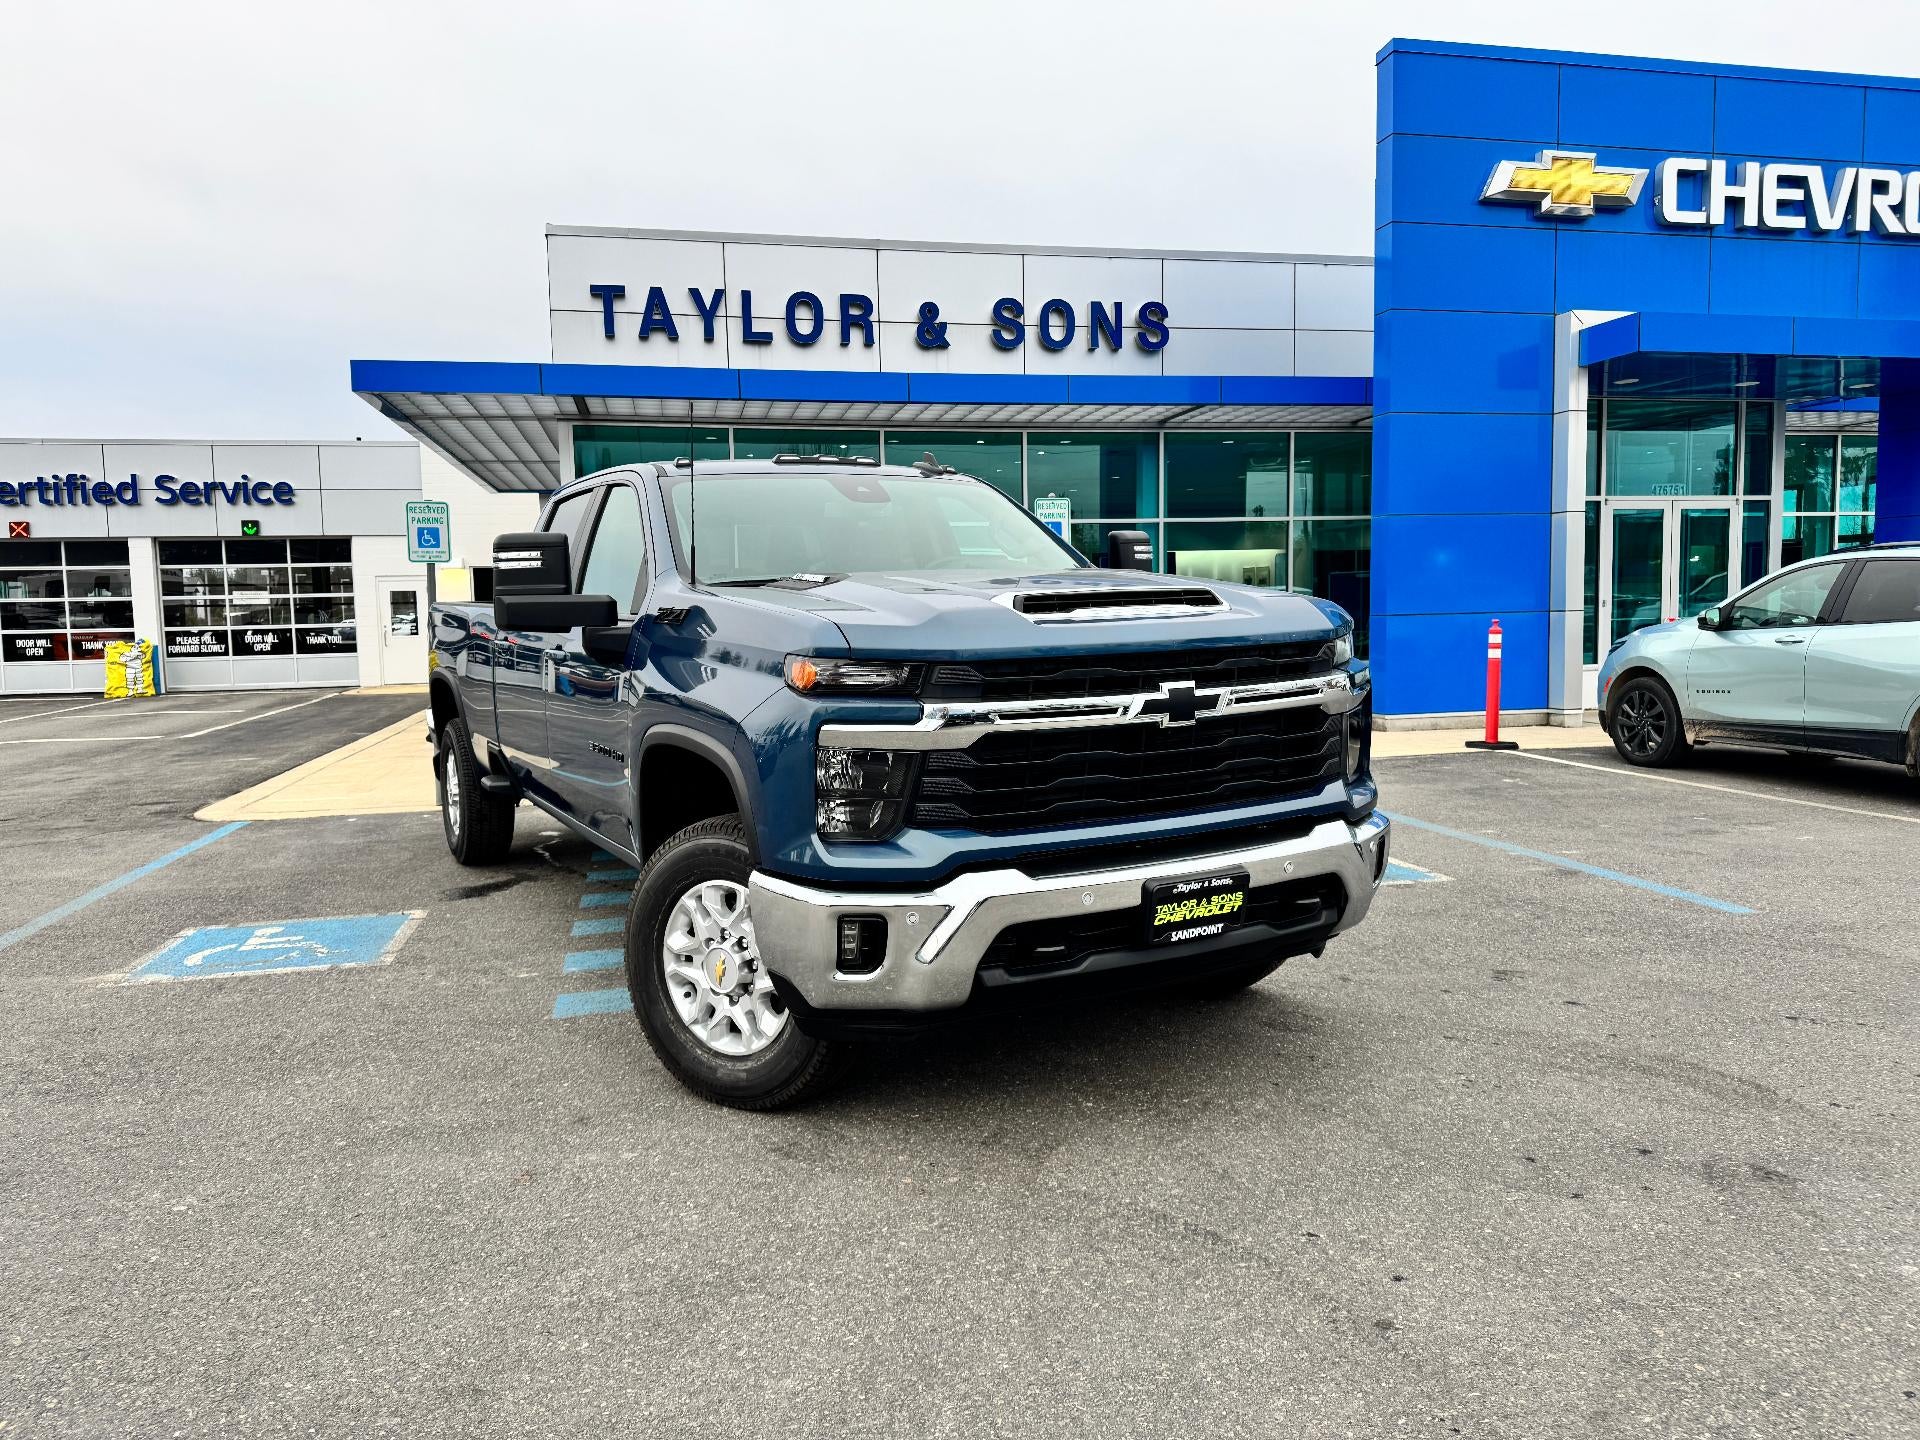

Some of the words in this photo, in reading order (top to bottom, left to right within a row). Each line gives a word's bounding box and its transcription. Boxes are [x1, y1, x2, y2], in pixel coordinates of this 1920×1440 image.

[589, 284, 875, 346] TAYLOR
[915, 301, 951, 349] &
[989, 296, 1171, 352] SONS
[0, 473, 140, 505] ertified
[154, 473, 296, 505] Service
[1651, 484, 1686, 496] 476751
[408, 505, 446, 514] RESERVED
[1037, 501, 1067, 510] RESERVED
[411, 516, 444, 525] PARKING
[16, 639, 35, 648] DOOR
[36, 638, 52, 648] WILL
[175, 636, 200, 645] PLEASE
[244, 634, 262, 644] DOOR
[305, 636, 327, 645] THANK
[81, 641, 104, 650] THANK
[168, 644, 200, 654] FORWARD
[200, 643, 226, 653] SLOWLY
[253, 643, 271, 652] OPEN
[26, 647, 44, 656] OPEN
[1176, 881, 1203, 893] Taylor
[1210, 877, 1231, 887] Sons
[1155, 898, 1197, 914] TAYLOR
[1199, 898, 1208, 908] &
[1210, 891, 1244, 905] SONS
[1153, 901, 1243, 926] CHEVROLET
[1170, 923, 1225, 942] SANDPOINT
